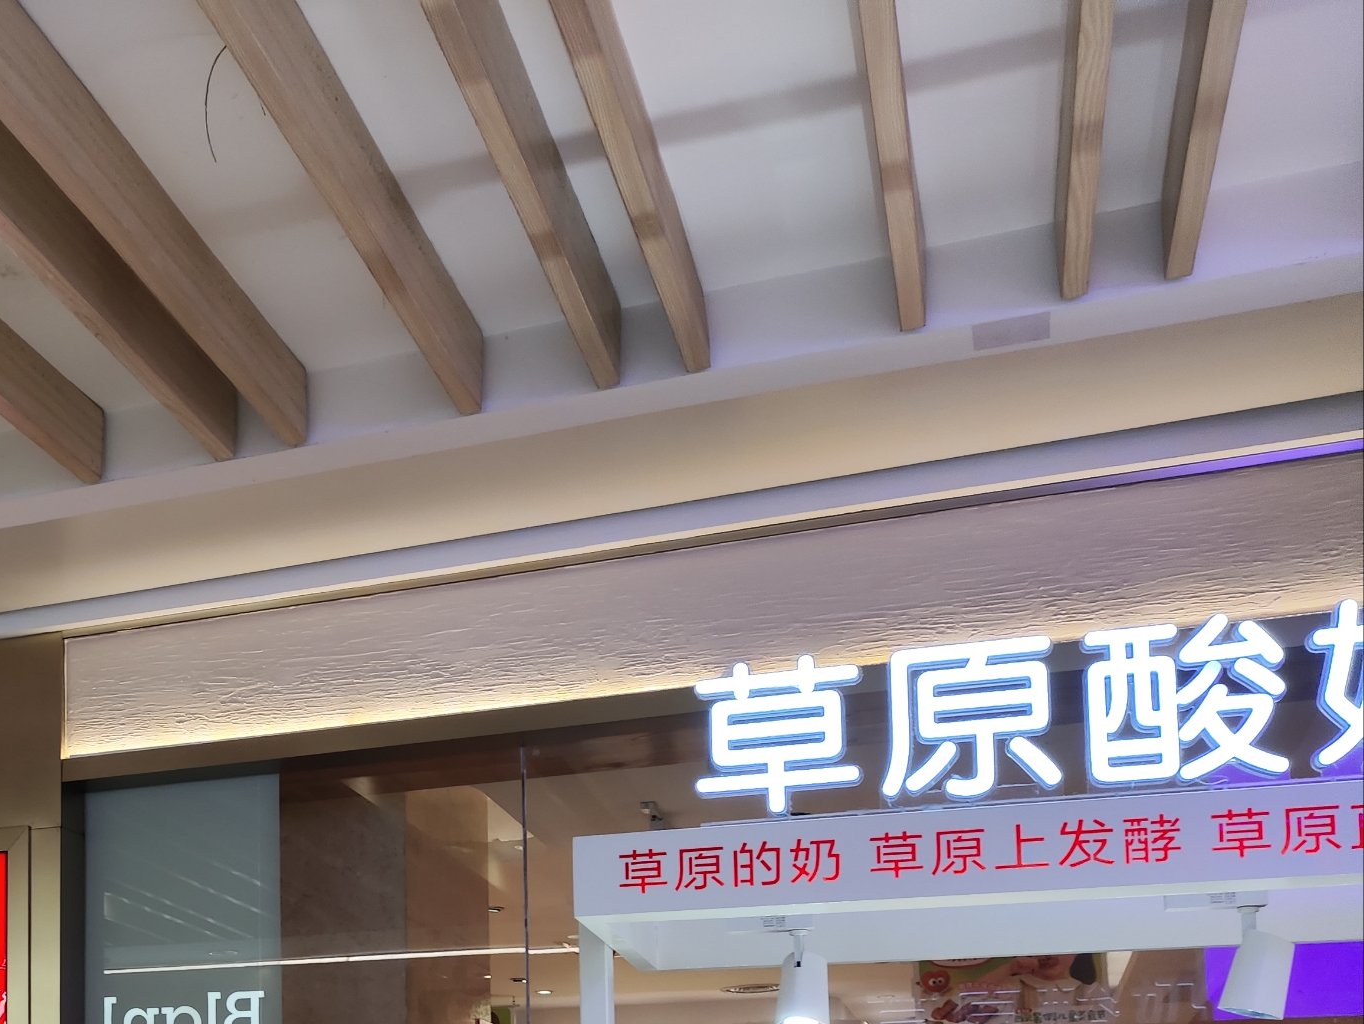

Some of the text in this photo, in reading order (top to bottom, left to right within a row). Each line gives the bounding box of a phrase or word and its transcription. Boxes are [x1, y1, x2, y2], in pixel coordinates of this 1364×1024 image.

[619, 804, 1363, 895] 草原的奶 草原上发酵 草原
